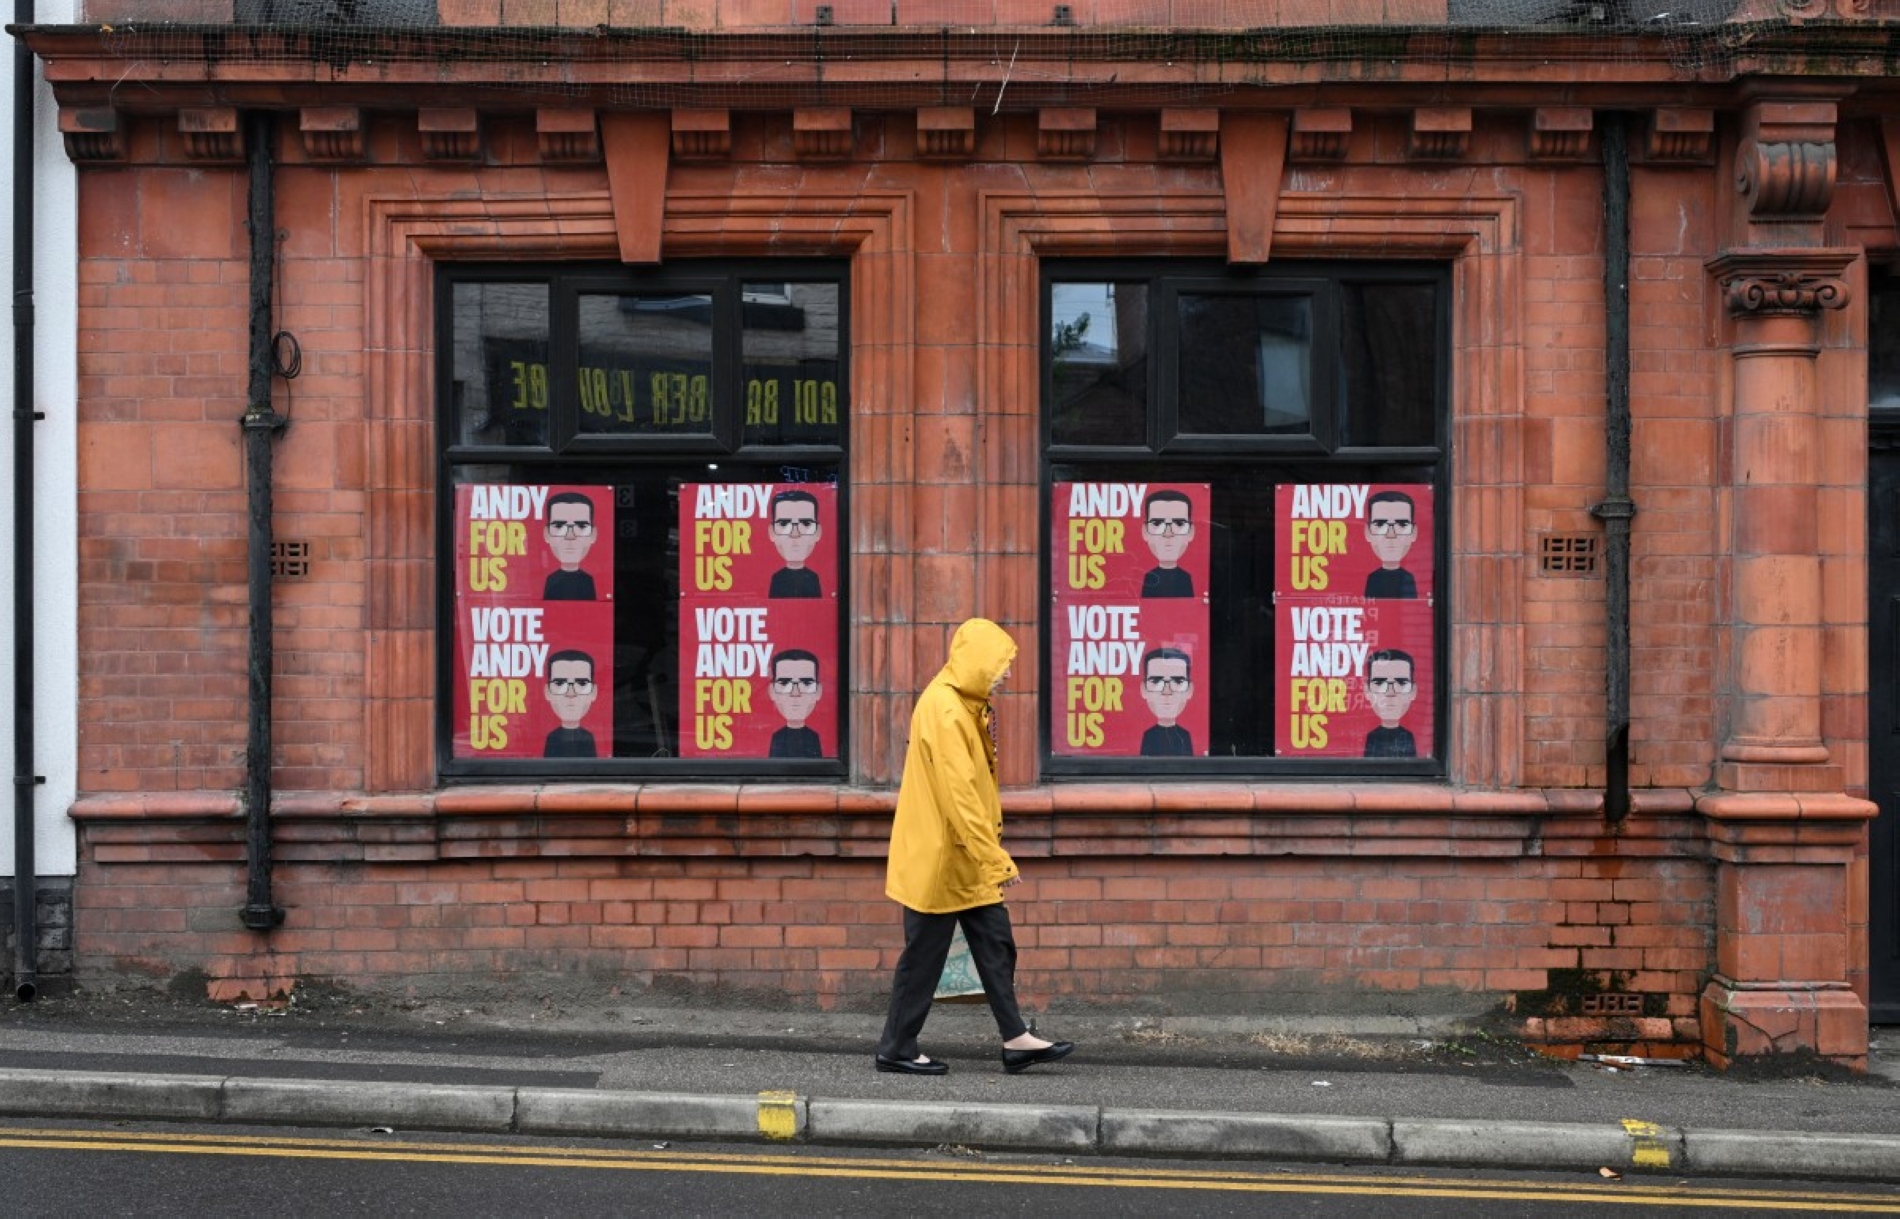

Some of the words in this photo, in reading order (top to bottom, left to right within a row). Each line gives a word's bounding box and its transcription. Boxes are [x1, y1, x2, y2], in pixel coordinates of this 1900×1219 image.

[469, 484, 549, 520] ANDY
[694, 484, 773, 519] ANDY
[1068, 482, 1147, 518] ANDY
[1291, 484, 1369, 519] ANDY
[469, 520, 528, 556] FOR
[694, 519, 752, 555] FOR
[1068, 518, 1125, 554] FOR
[1291, 519, 1348, 556] FOR
[469, 556, 508, 592] US
[694, 555, 734, 591] US
[1068, 554, 1107, 590] US
[1290, 555, 1329, 591] US
[470, 606, 545, 643] VOTE
[695, 606, 769, 643] VOTE
[1067, 604, 1141, 641] VOTE
[1290, 606, 1364, 643] VOTE
[470, 643, 550, 678] ANDY
[695, 643, 774, 678] ANDY
[1067, 640, 1146, 676] ANDY
[1290, 641, 1370, 677] ANDY
[470, 678, 528, 714] FOR
[695, 678, 752, 714] FOR
[1067, 676, 1124, 712] FOR
[1290, 677, 1348, 714] FOR
[470, 714, 508, 750] US
[695, 714, 734, 750] US
[1066, 712, 1105, 748] US
[1290, 714, 1329, 750] US
